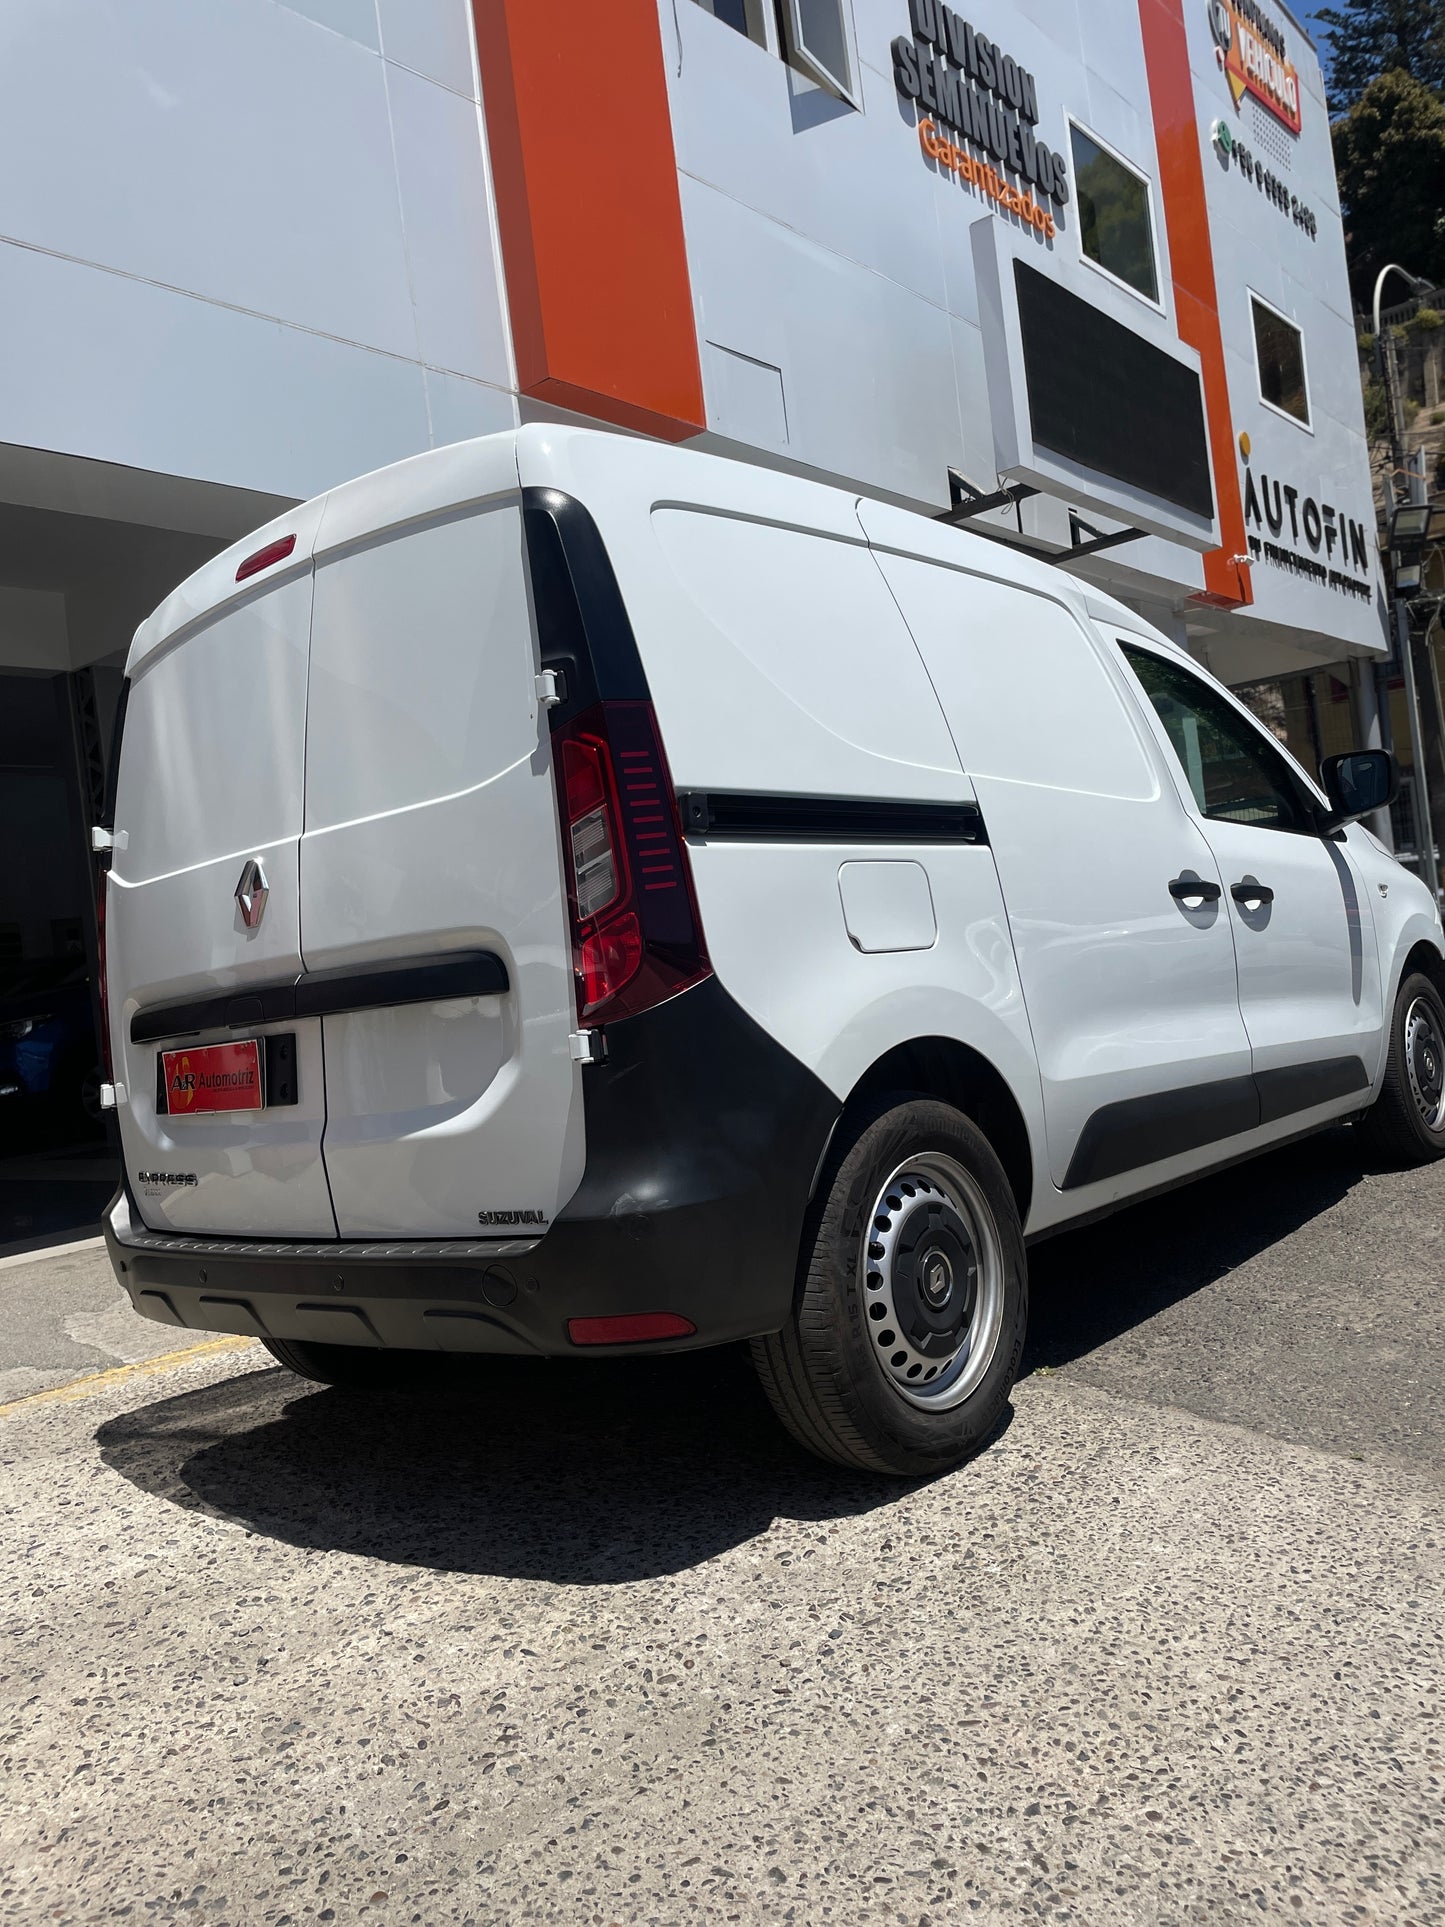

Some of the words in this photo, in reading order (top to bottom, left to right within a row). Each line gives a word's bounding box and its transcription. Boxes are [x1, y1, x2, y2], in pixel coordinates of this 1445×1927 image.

[908, 0, 1039, 126] DIVISION
[890, 35, 1069, 206] SEMINUEVOS
[918, 117, 1055, 238] Garantizados
[1244, 466, 1368, 570] AUTOFIN
[198, 1067, 254, 1088] Automotriz
[139, 1171, 198, 1186] EXPRESS
[478, 1209, 549, 1225] SUZUVAL
